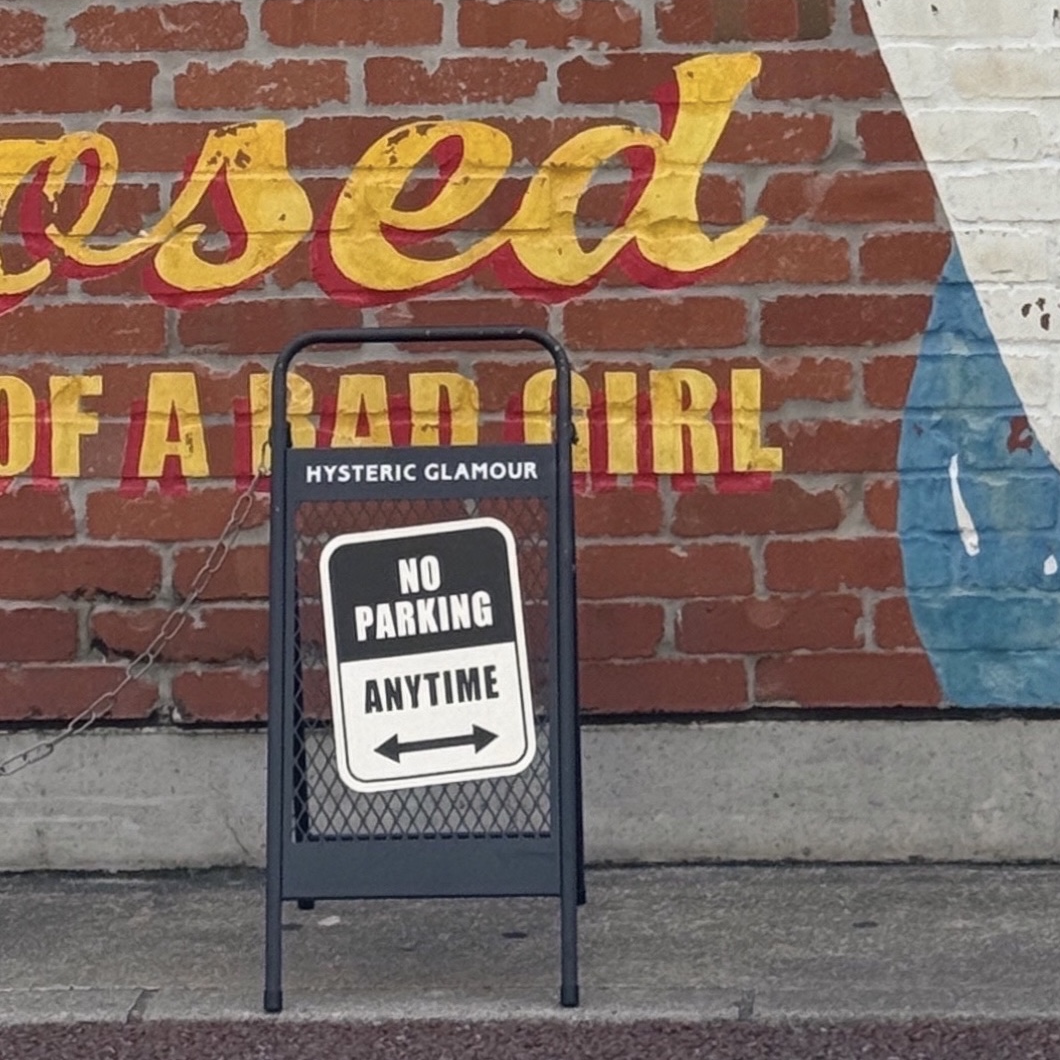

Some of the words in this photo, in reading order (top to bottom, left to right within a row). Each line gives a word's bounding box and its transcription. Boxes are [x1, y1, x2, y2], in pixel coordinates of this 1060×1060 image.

[138, 371, 210, 477] A
[305, 463, 417, 483] HYSTERIC
[424, 461, 538, 481] GLAMOUR
[398, 555, 441, 595] NO
[354, 590, 493, 641] PARKING
[364, 665, 499, 714] ANYTIME
